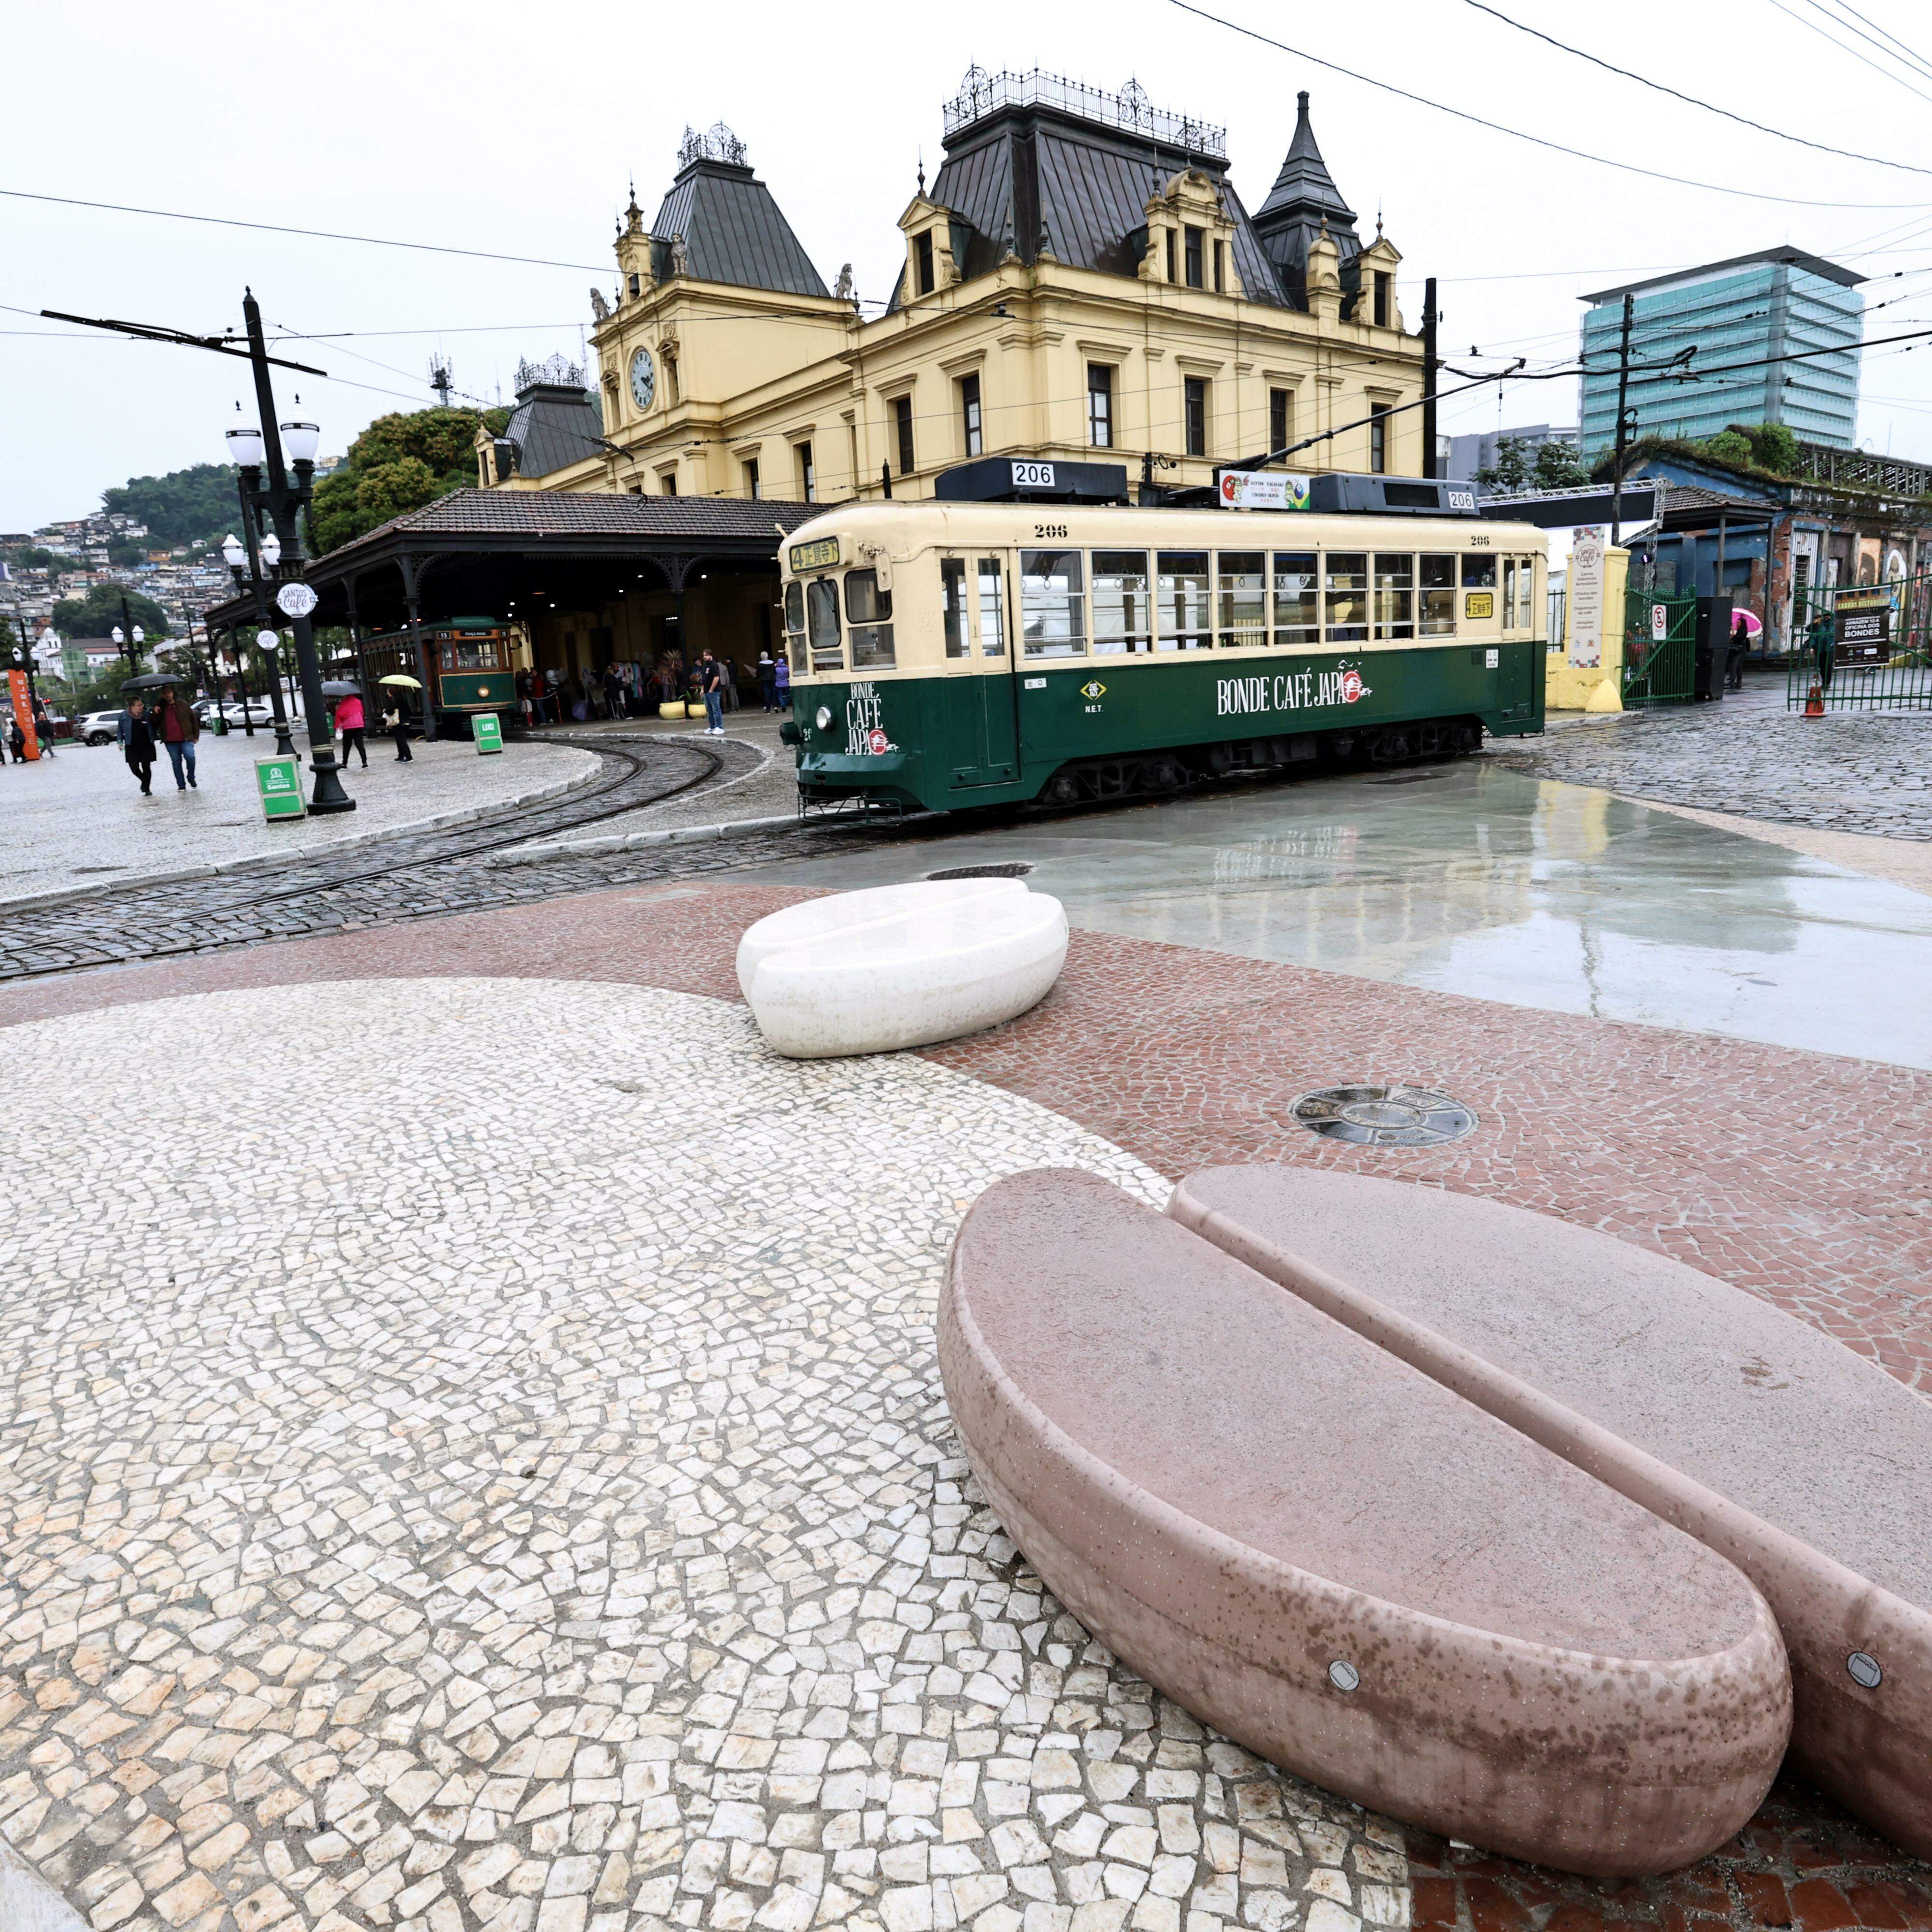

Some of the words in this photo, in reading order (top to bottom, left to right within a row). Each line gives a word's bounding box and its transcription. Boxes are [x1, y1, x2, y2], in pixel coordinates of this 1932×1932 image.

[1016, 465, 1051, 483] 206
[1451, 494, 1472, 507] 206
[1035, 525, 1068, 538] 206
[1471, 536, 1490, 546] 206
[794, 548, 803, 568] 4
[1845, 628, 1880, 638] BONDES
[850, 682, 875, 699] BONDE
[1217, 676, 1270, 715] BONDE
[1274, 667, 1313, 710] CAFÉ
[846, 694, 883, 730] CAFÉ
[1085, 705, 1104, 713] N.E.T.
